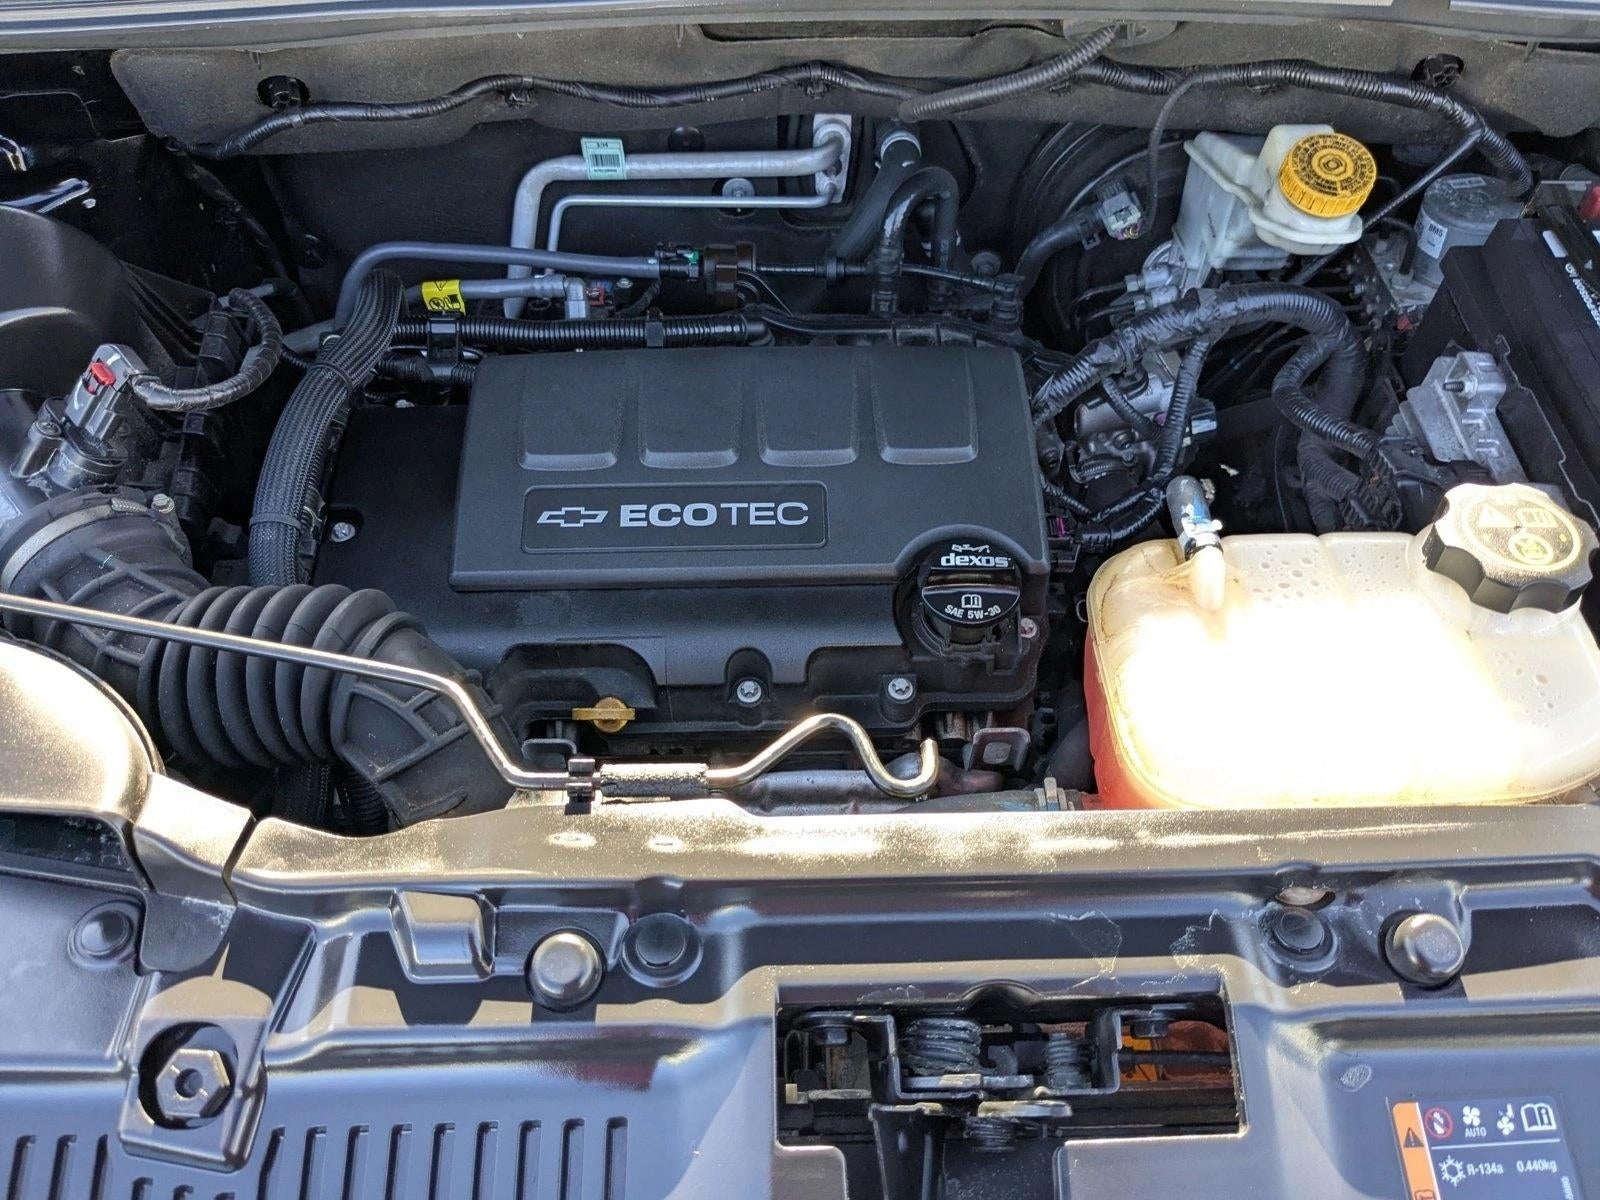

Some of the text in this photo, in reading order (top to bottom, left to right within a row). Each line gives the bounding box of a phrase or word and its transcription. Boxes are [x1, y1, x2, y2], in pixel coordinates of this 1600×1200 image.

[620, 502, 809, 527] ECOTEC
[940, 553, 1009, 567] dexos
[945, 604, 1001, 619] SAE 5W-30
[1465, 1127, 1487, 1138] AUTO
[1467, 1158, 1557, 1175] R-134a 0.440kg
